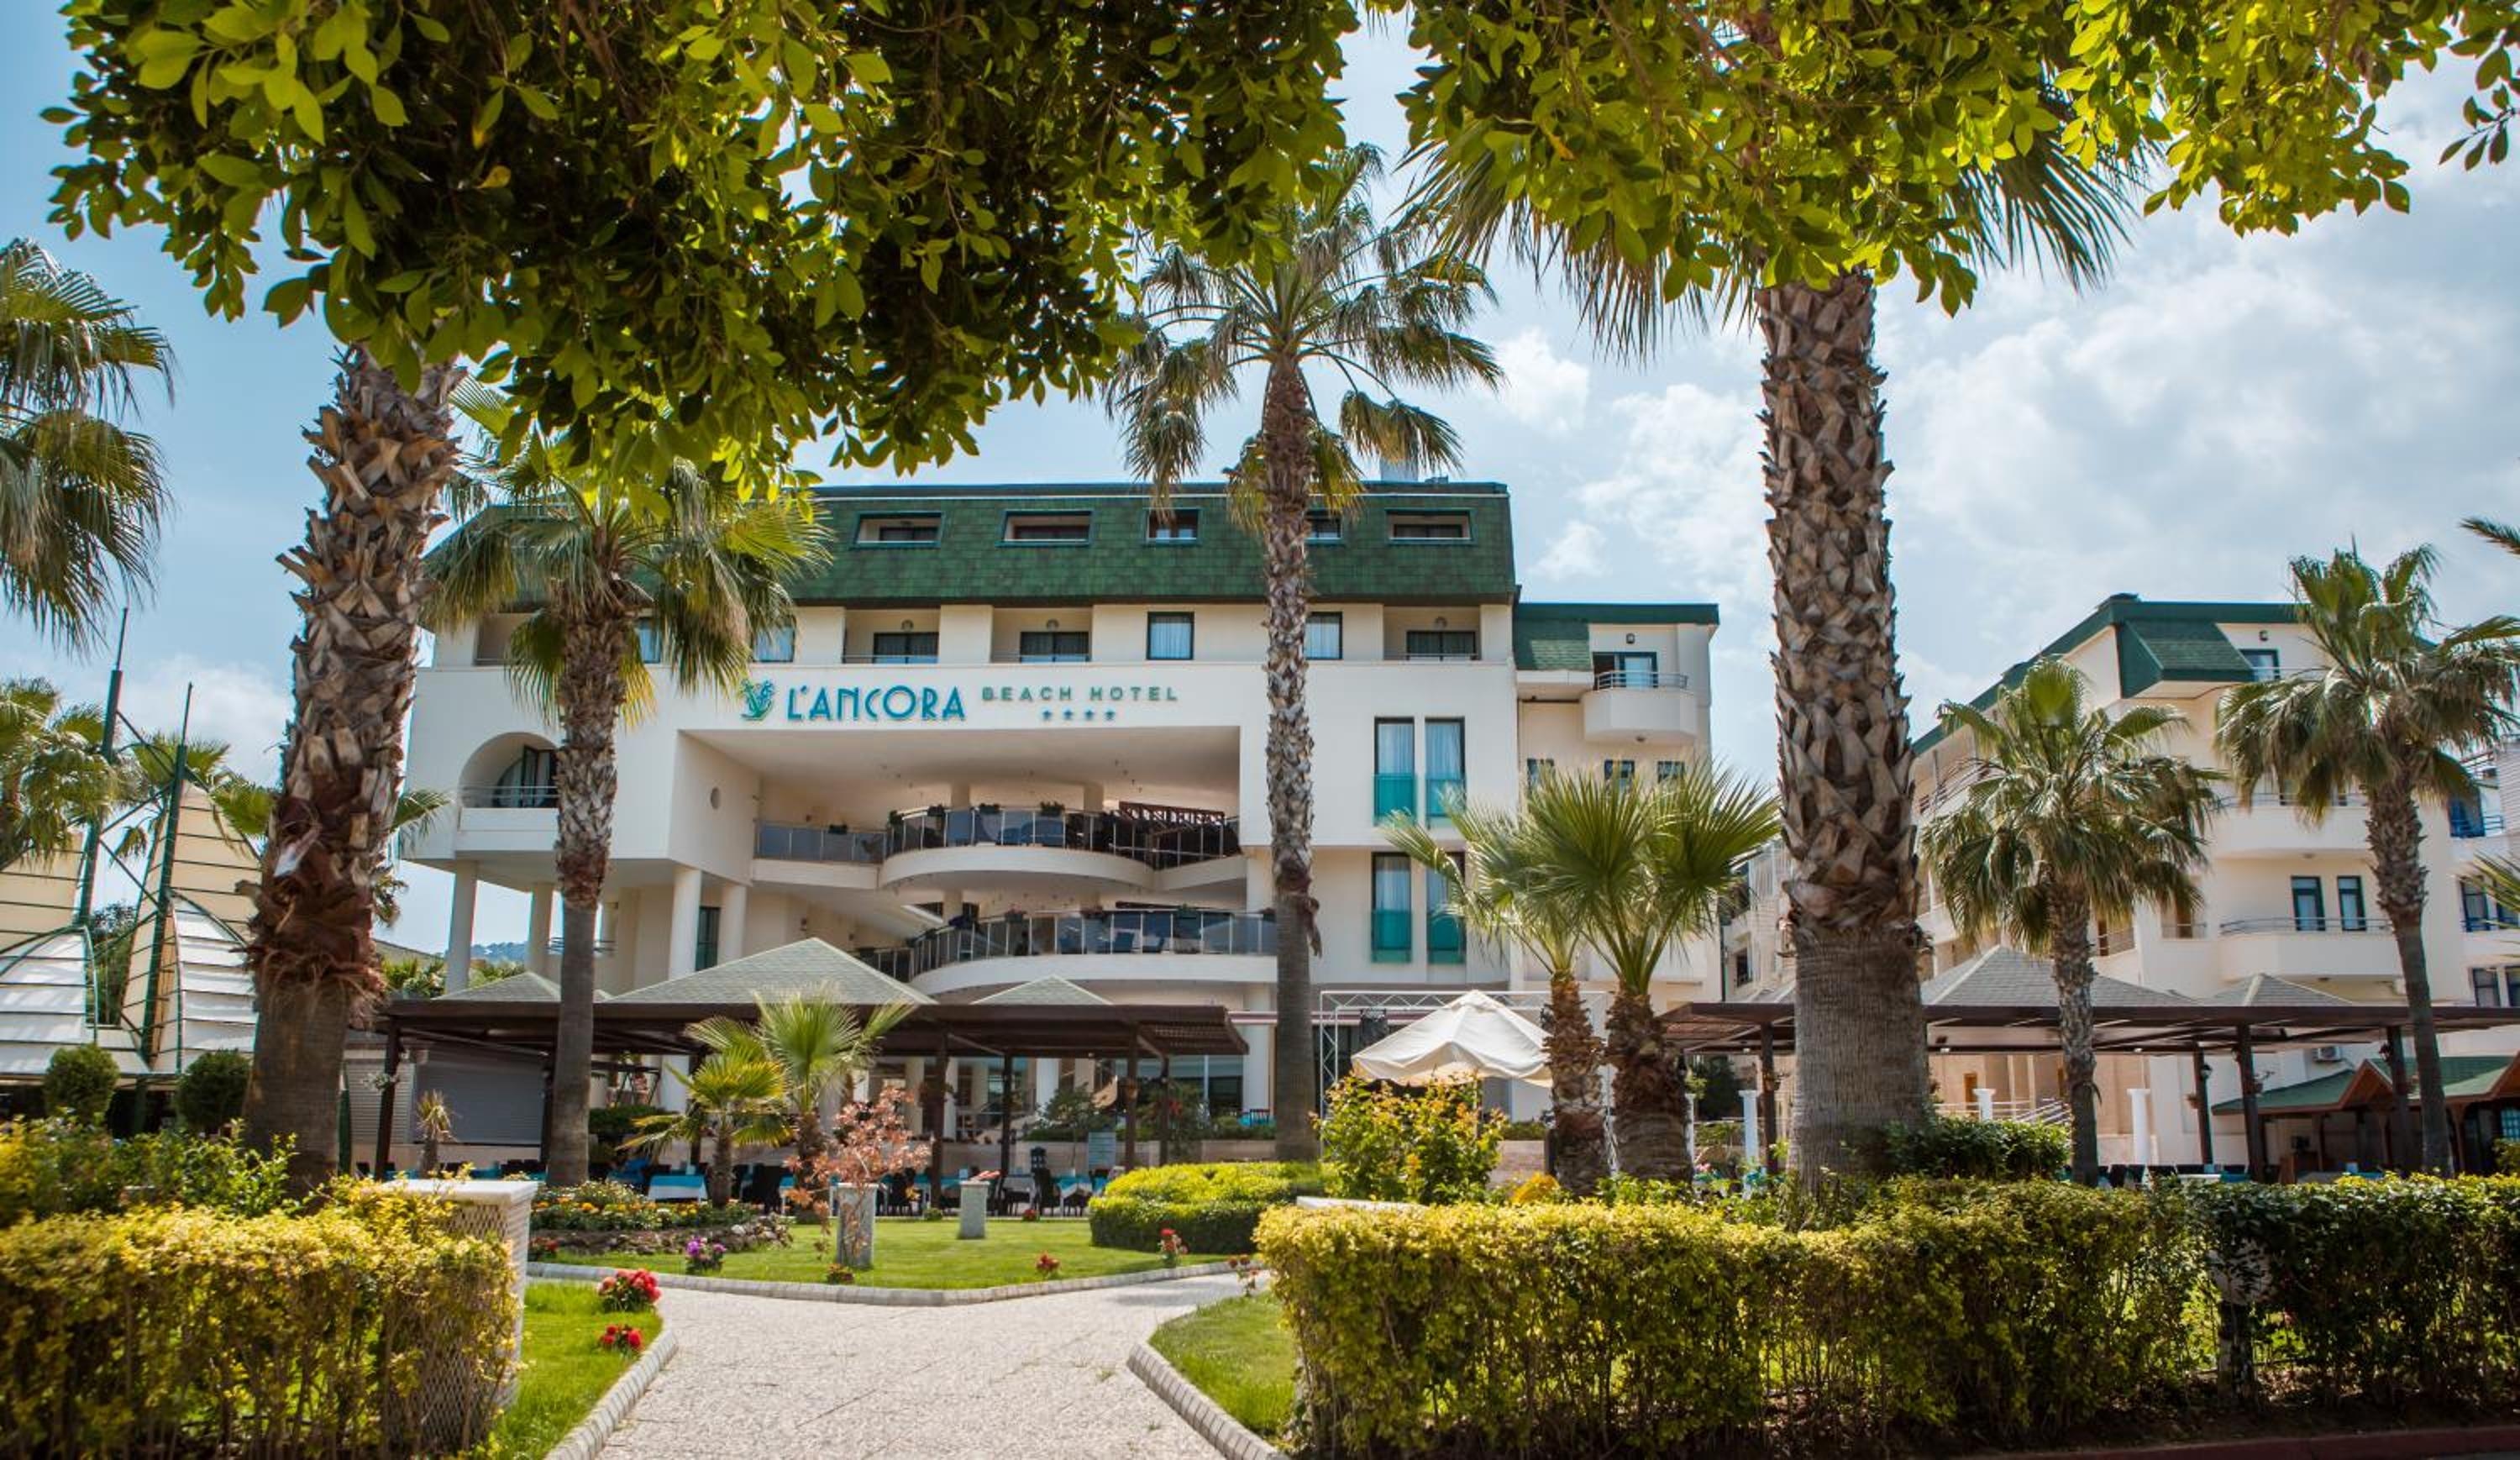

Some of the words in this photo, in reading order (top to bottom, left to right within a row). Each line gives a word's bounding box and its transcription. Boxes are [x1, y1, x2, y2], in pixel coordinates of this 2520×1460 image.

[787, 685, 965, 720] L'ANCORA
[982, 686, 1072, 701] BEACH
[1089, 686, 1178, 701] HOTEL
